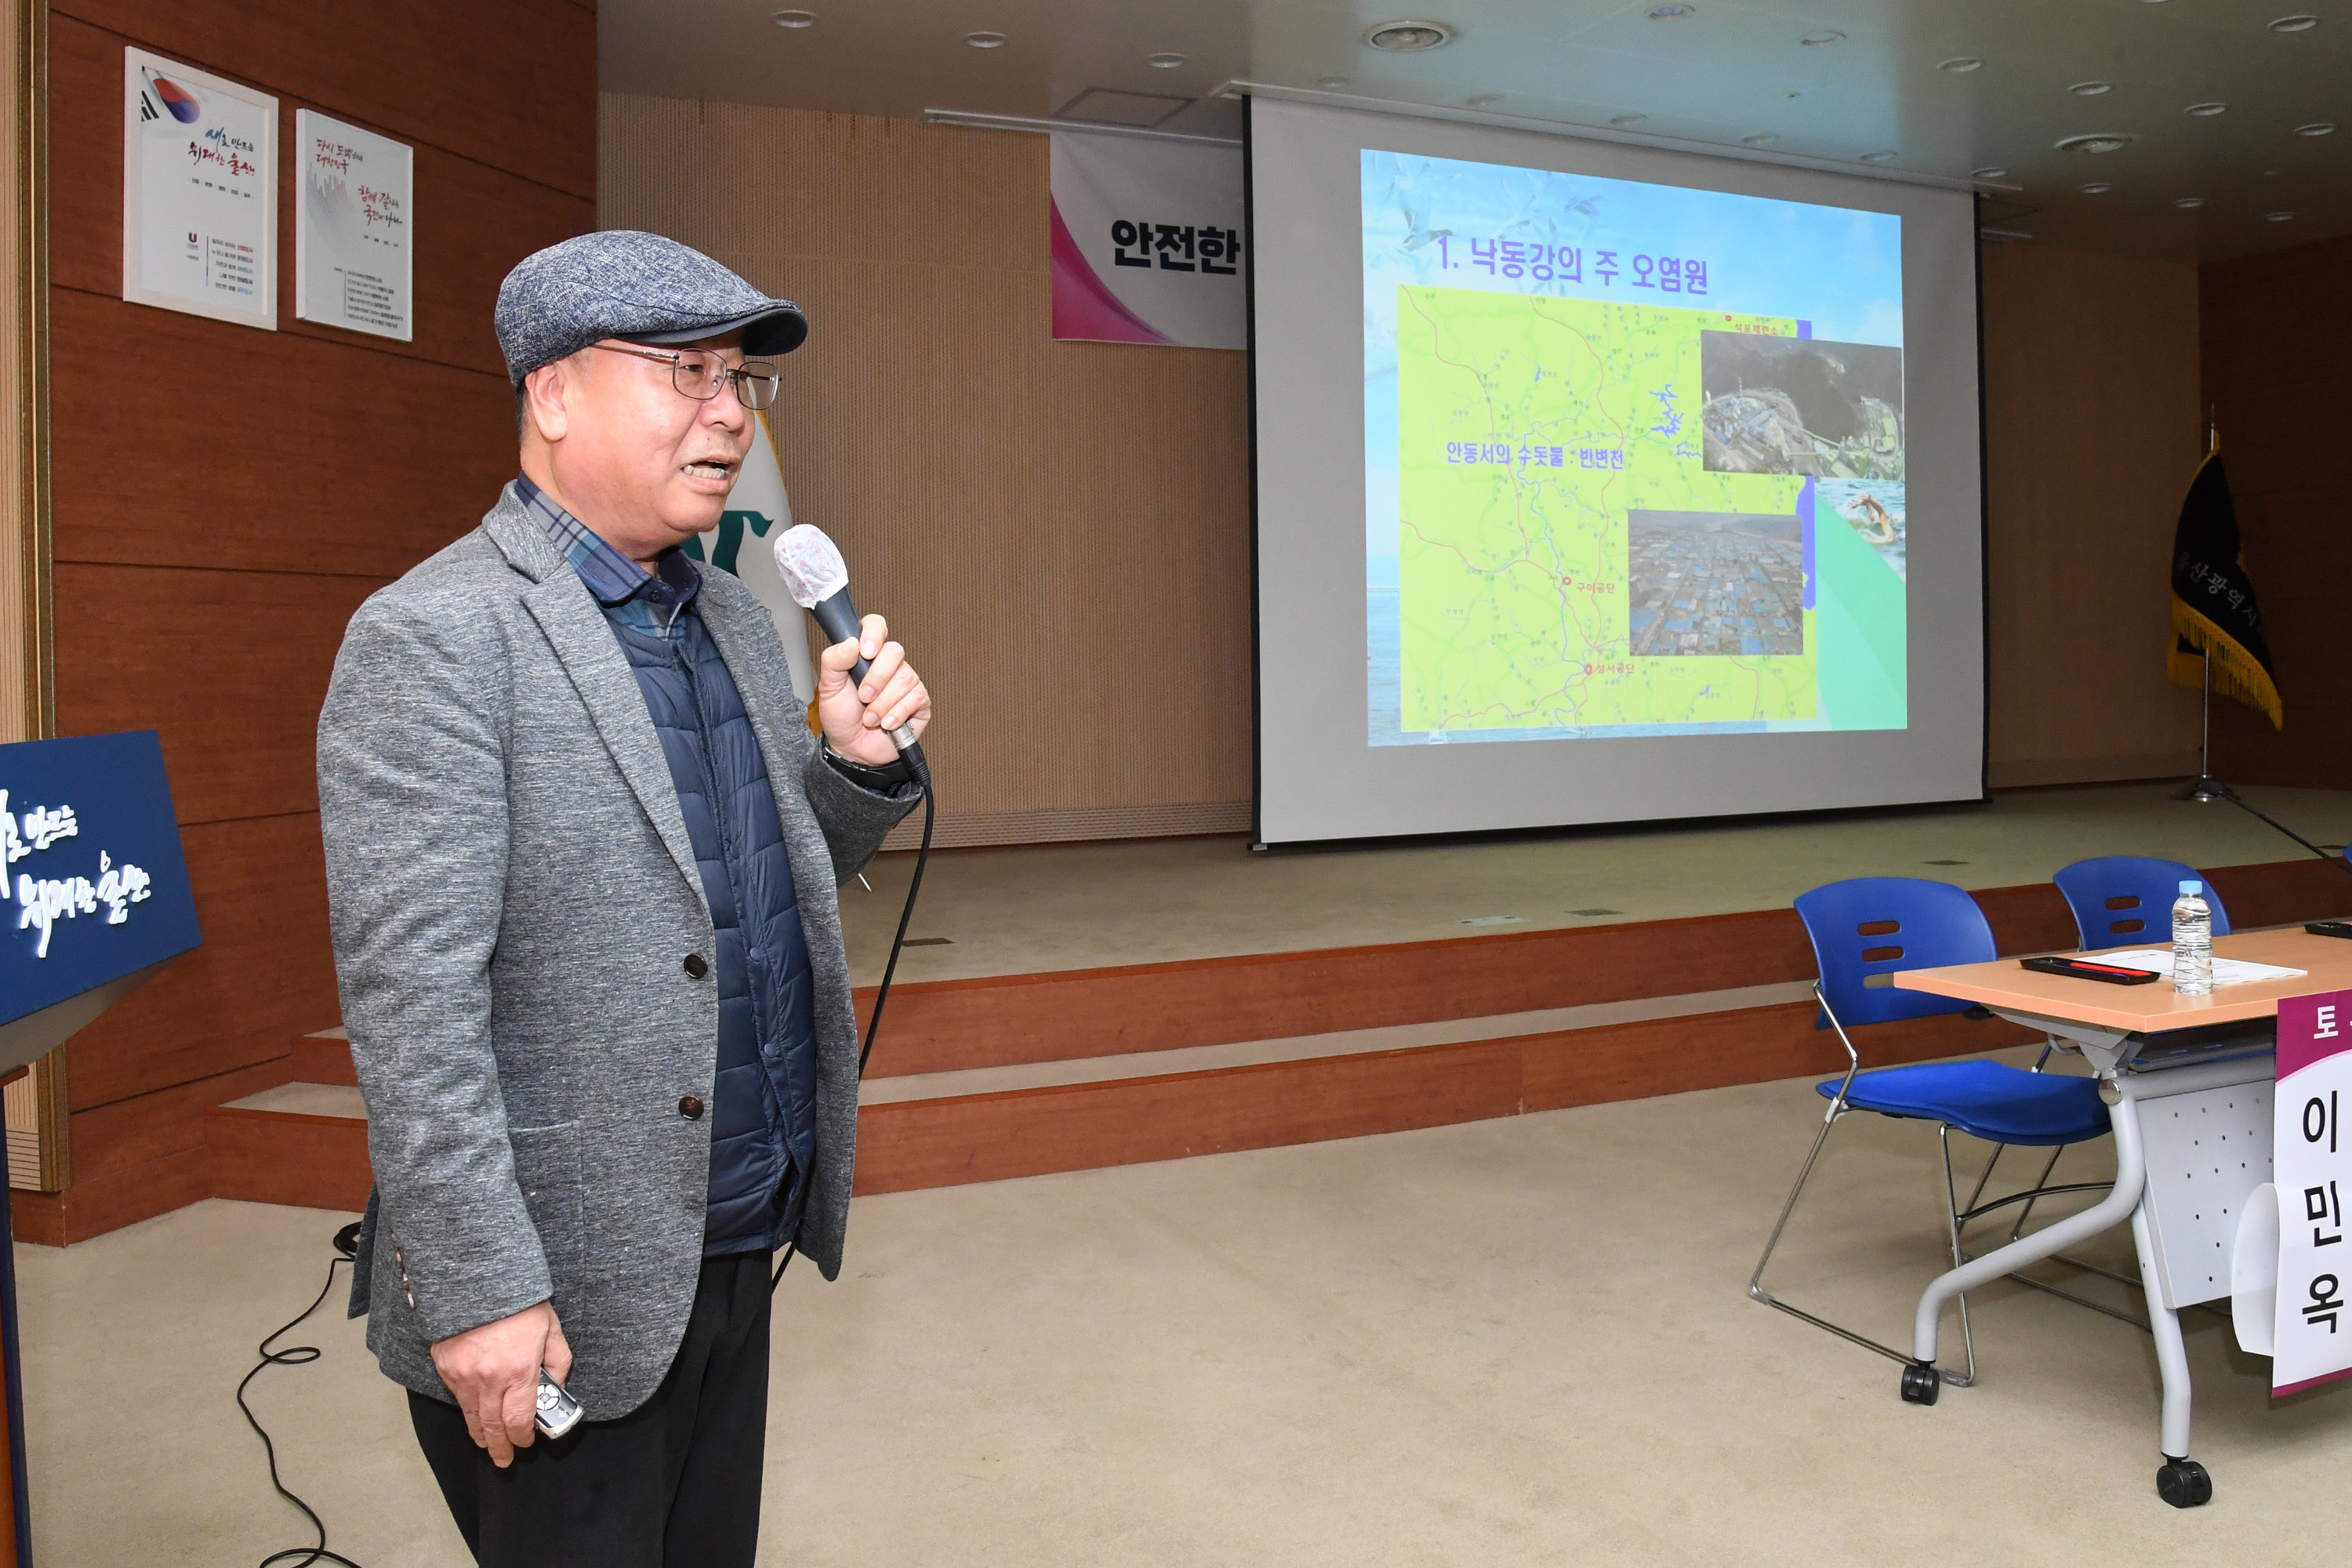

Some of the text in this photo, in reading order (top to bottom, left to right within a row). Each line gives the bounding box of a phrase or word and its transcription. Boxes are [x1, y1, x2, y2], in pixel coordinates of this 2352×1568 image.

[1111, 220, 1241, 276] 안전한
[1438, 236, 1708, 296] 1. 낙동강의 주 오염원
[2314, 1005, 2352, 1040] 토
